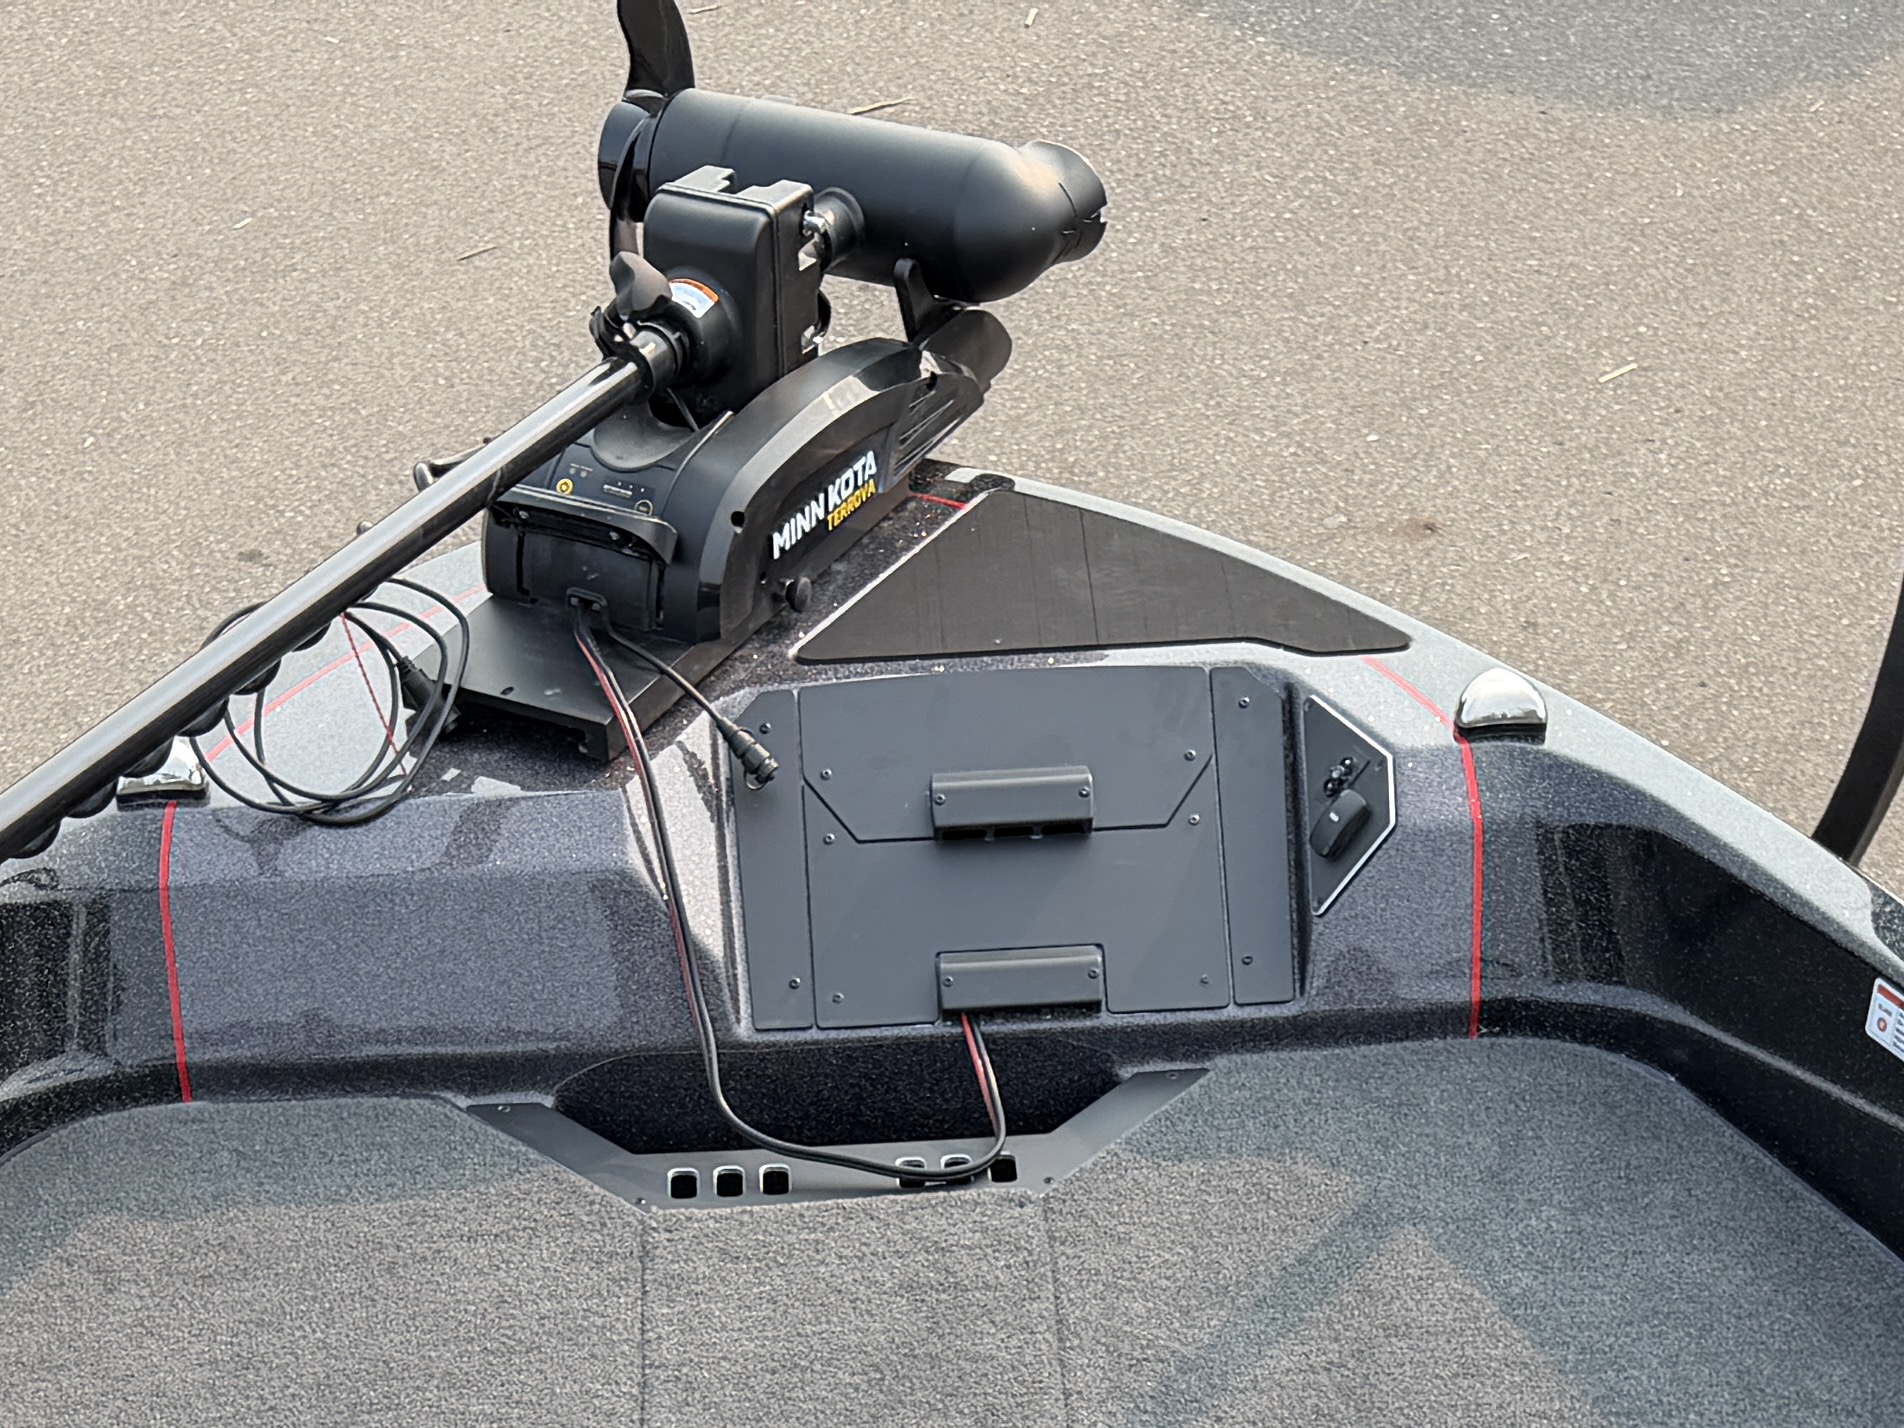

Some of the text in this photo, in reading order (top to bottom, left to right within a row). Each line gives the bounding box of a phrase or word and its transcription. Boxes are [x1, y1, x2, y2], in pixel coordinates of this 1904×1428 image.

[772, 450, 877, 560] MINN KOTA
[827, 479, 876, 531] TERROVA
